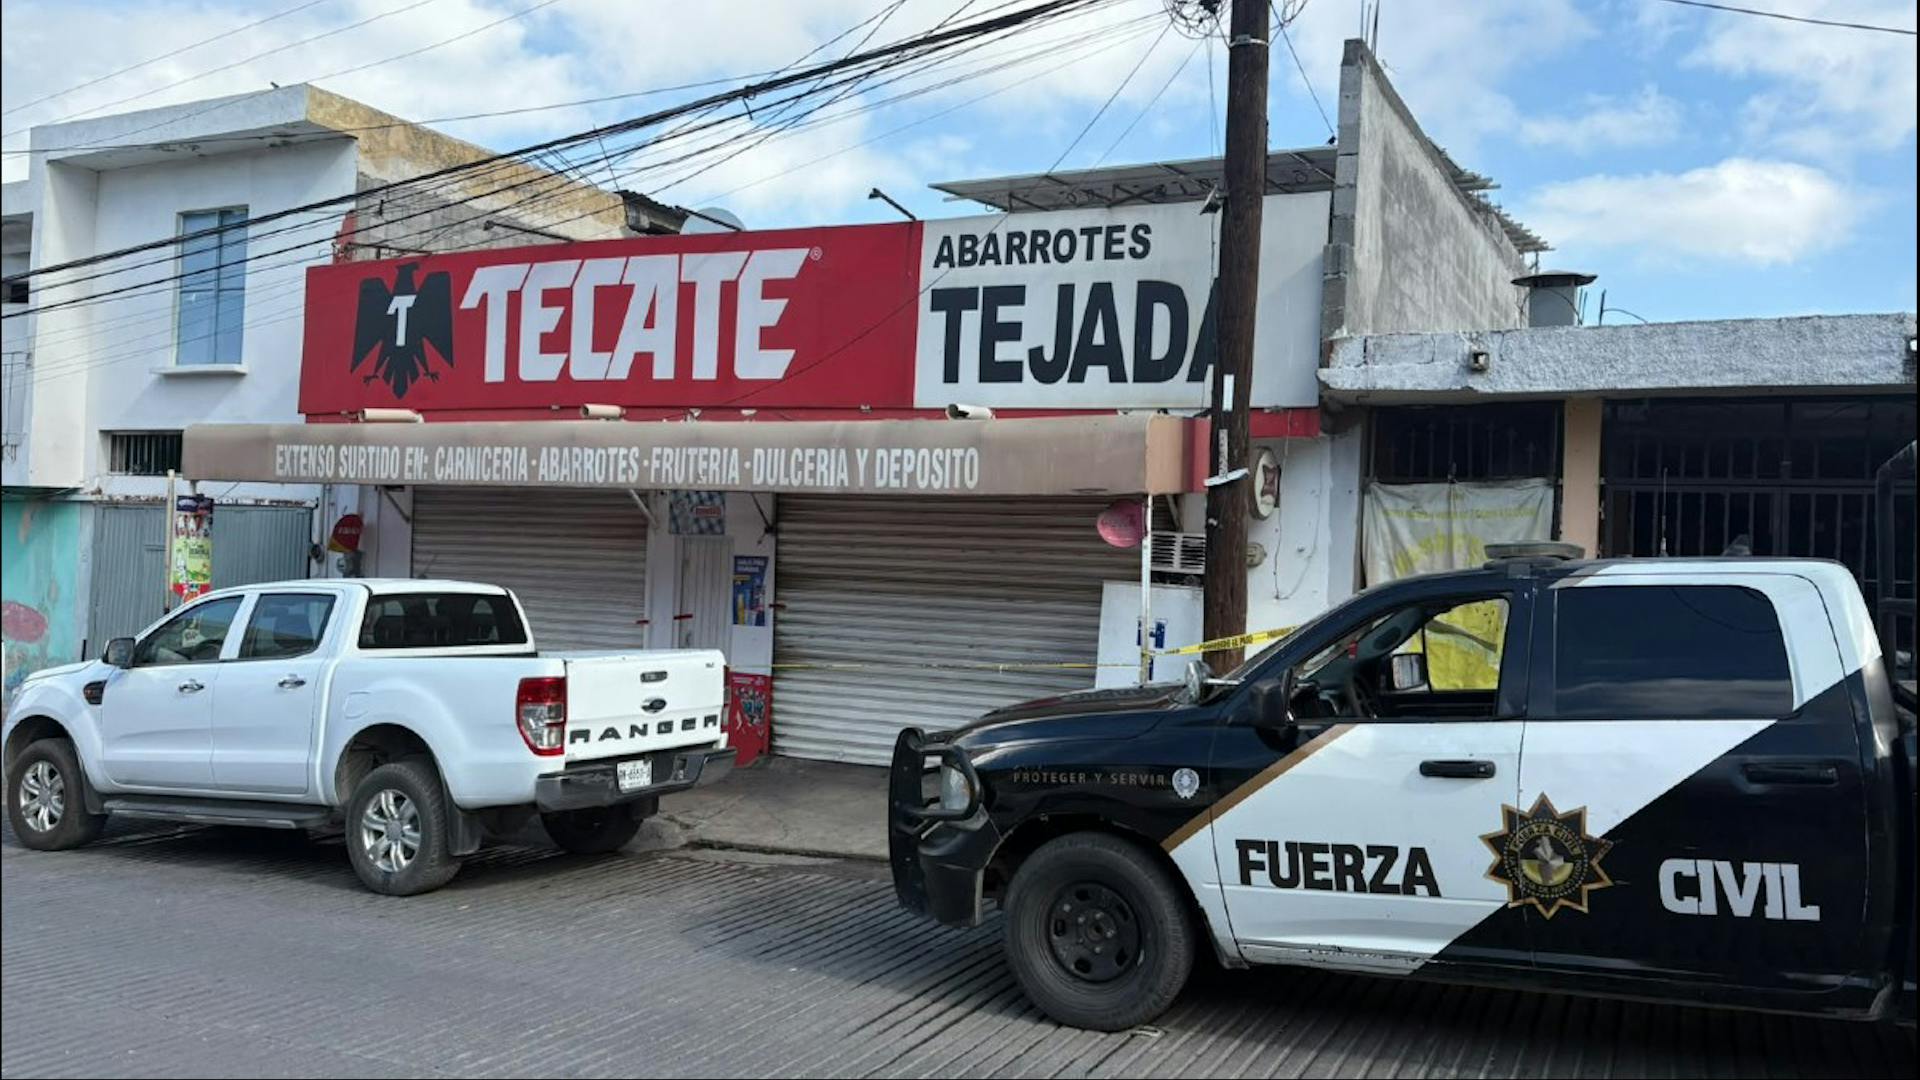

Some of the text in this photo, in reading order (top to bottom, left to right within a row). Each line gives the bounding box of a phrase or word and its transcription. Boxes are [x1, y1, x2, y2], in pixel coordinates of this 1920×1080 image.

[933, 223, 1152, 269] ABARROTES
[387, 294, 417, 347] T
[460, 247, 810, 383] TECATE
[275, 445, 979, 489] EXTENSO SURTIDO EN: CARNICERIA ABARROTES FRUTERIA DULCERIA Y DEPOSITO
[569, 714, 718, 745] RANGER
[1013, 772, 1165, 786] PROTEGER Y SERVIR
[1235, 838, 1442, 897] FUERZA
[1658, 857, 1821, 922] CIVIL
